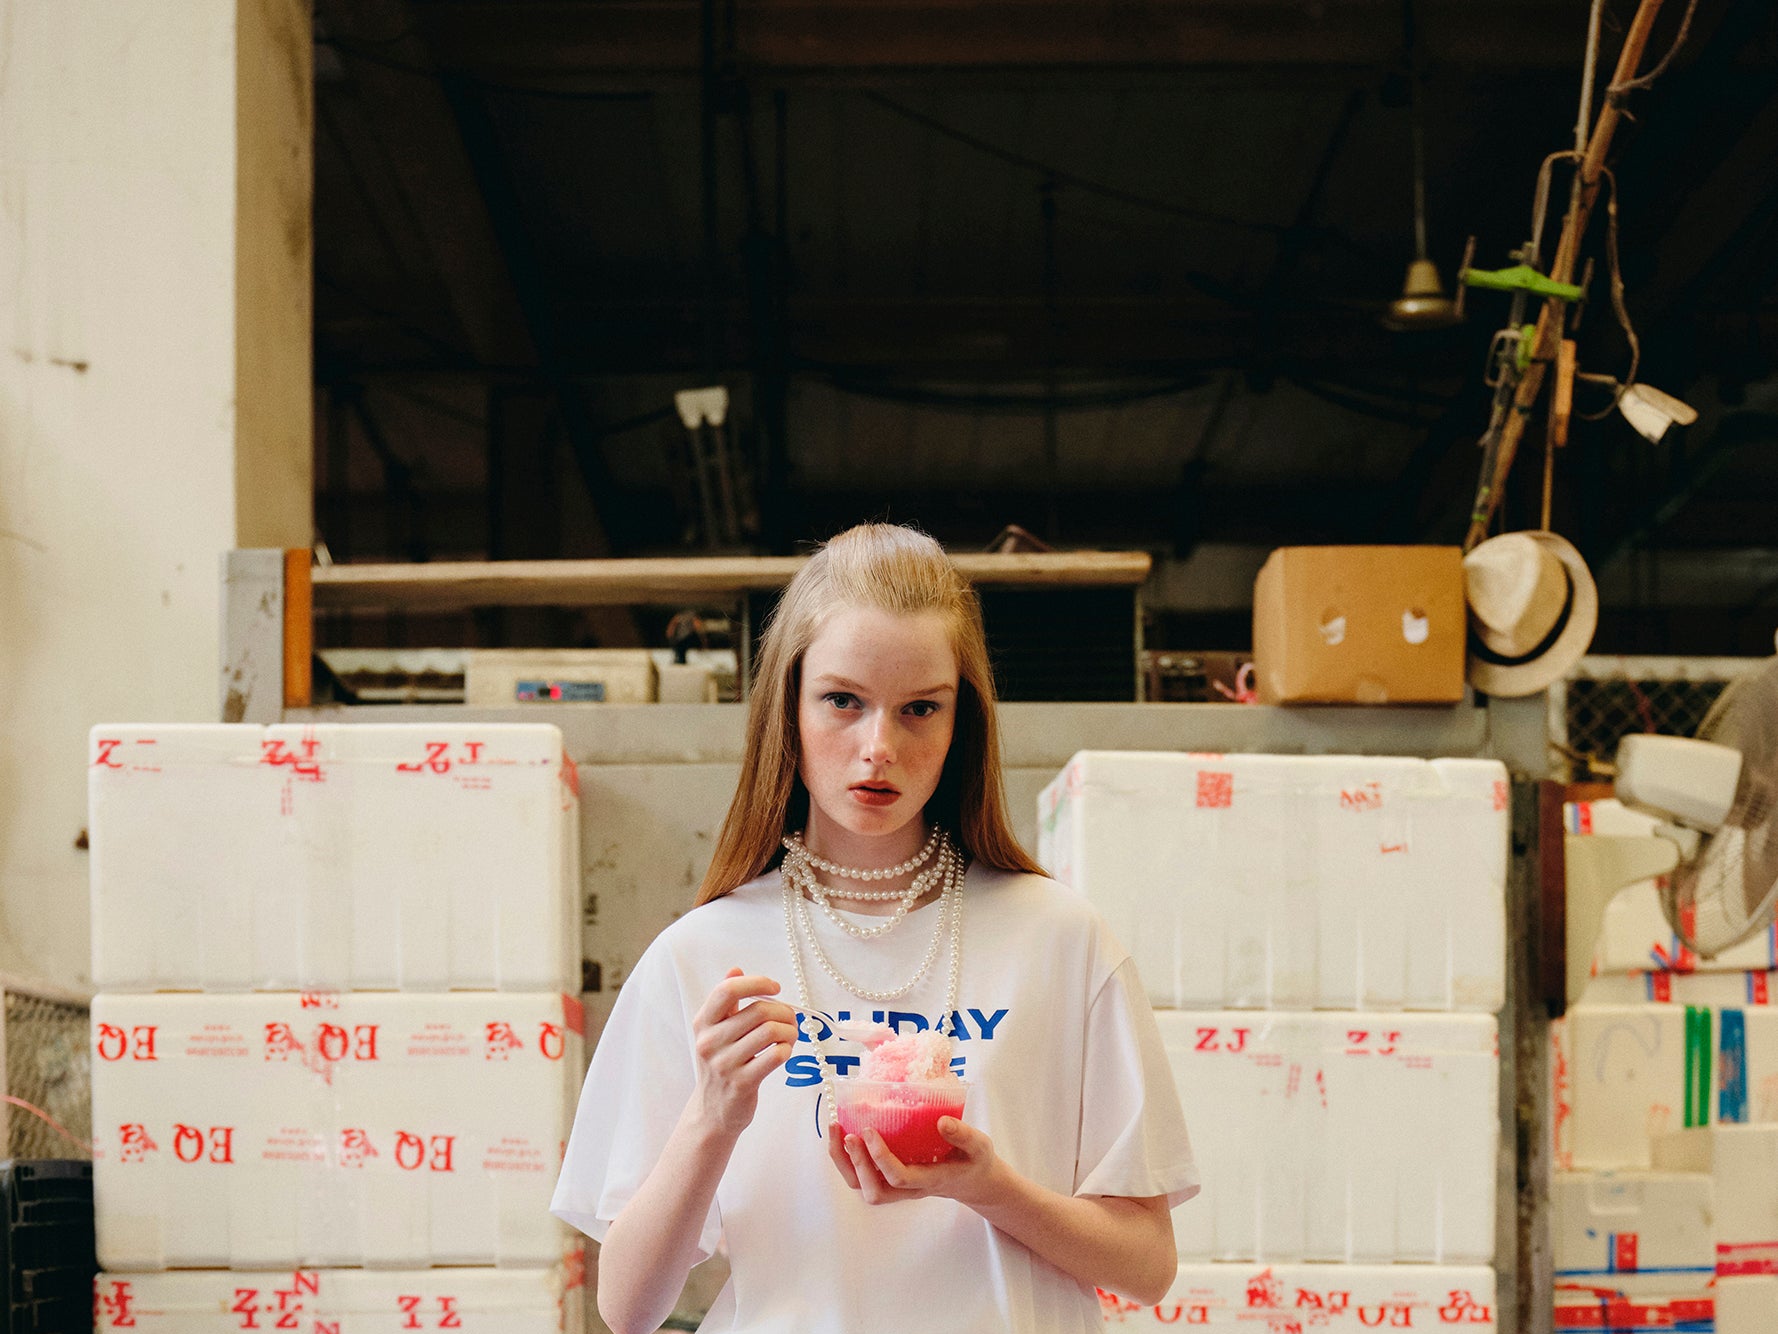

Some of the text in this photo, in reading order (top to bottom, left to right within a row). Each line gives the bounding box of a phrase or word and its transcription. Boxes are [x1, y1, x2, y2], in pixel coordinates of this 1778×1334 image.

[539, 1022, 567, 1061] Q
[173, 1123, 235, 1164] EQ
[395, 1131, 456, 1172] EQ
